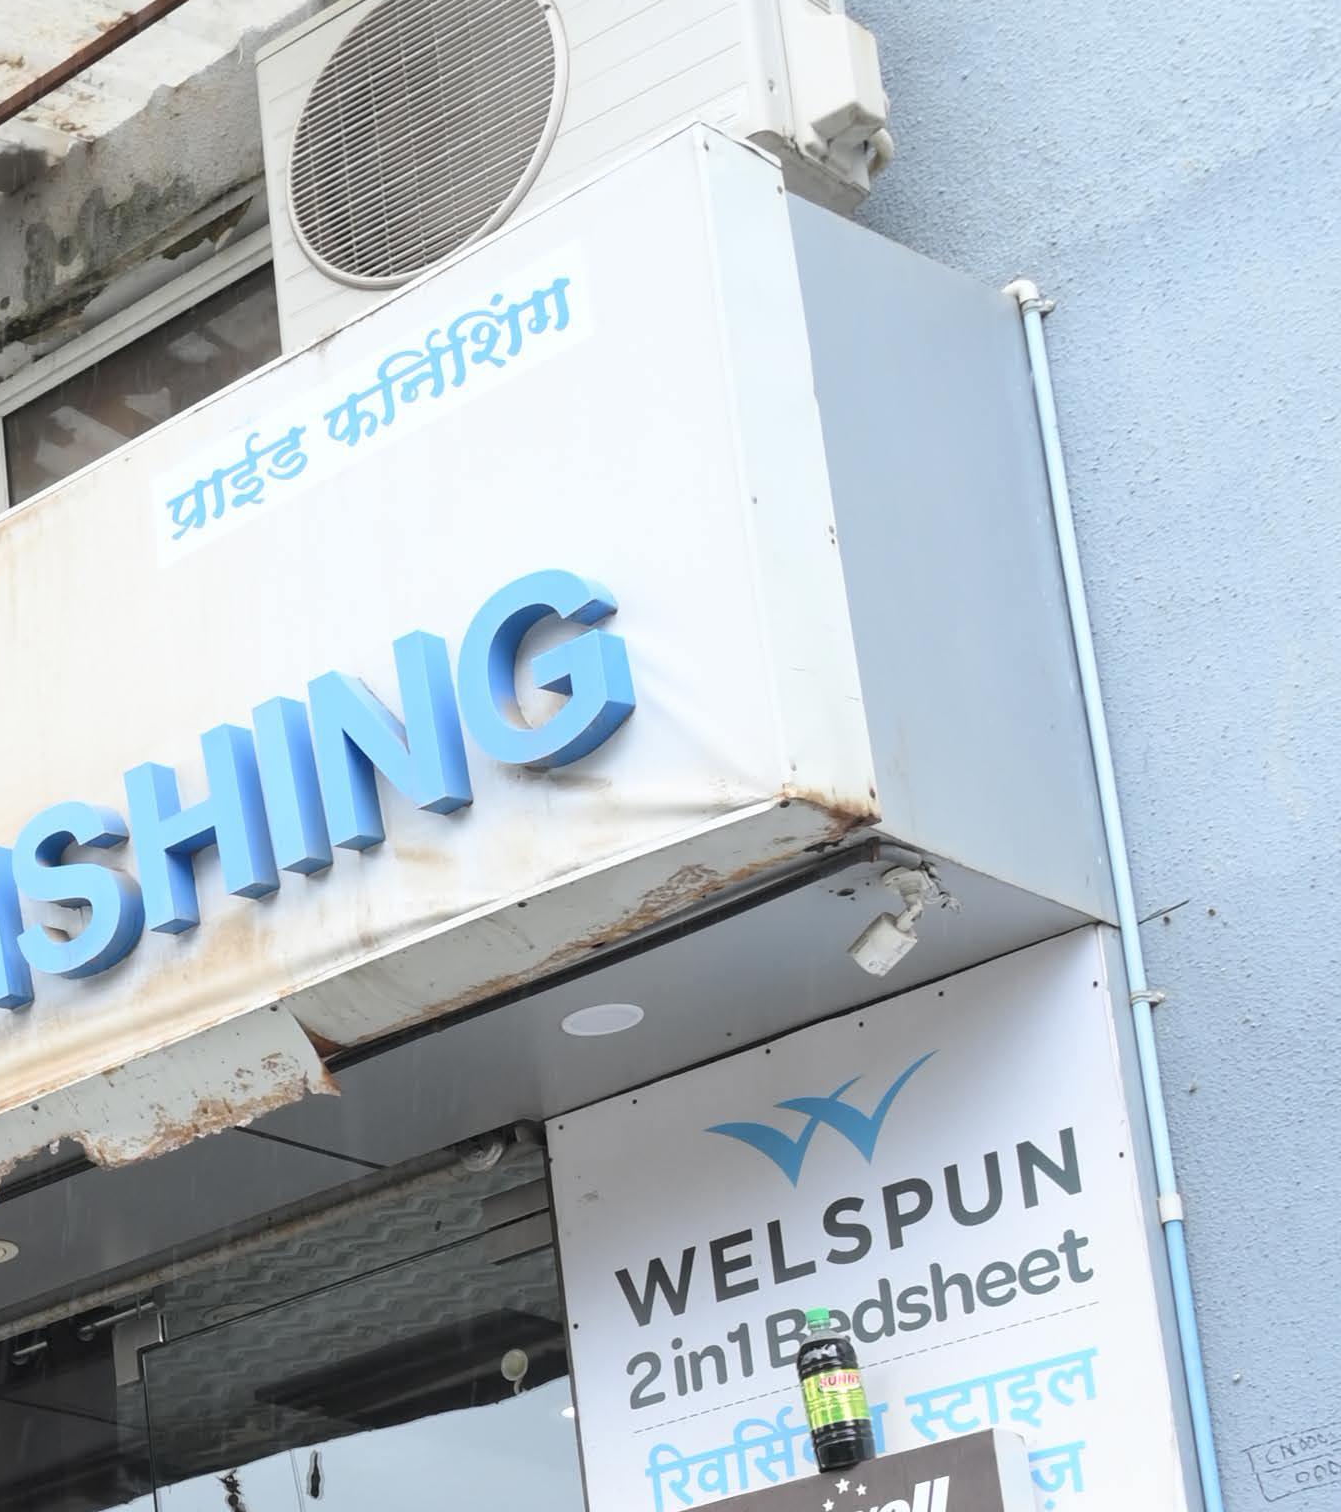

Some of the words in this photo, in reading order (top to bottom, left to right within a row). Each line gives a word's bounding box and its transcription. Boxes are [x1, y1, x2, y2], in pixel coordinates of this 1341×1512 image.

[166, 423, 310, 546] प्राईड
[324, 277, 574, 452] फर्निशिंग
[615, 1128, 1083, 1327] WELSPUN
[905, 1347, 1098, 1441] स्टाइल
